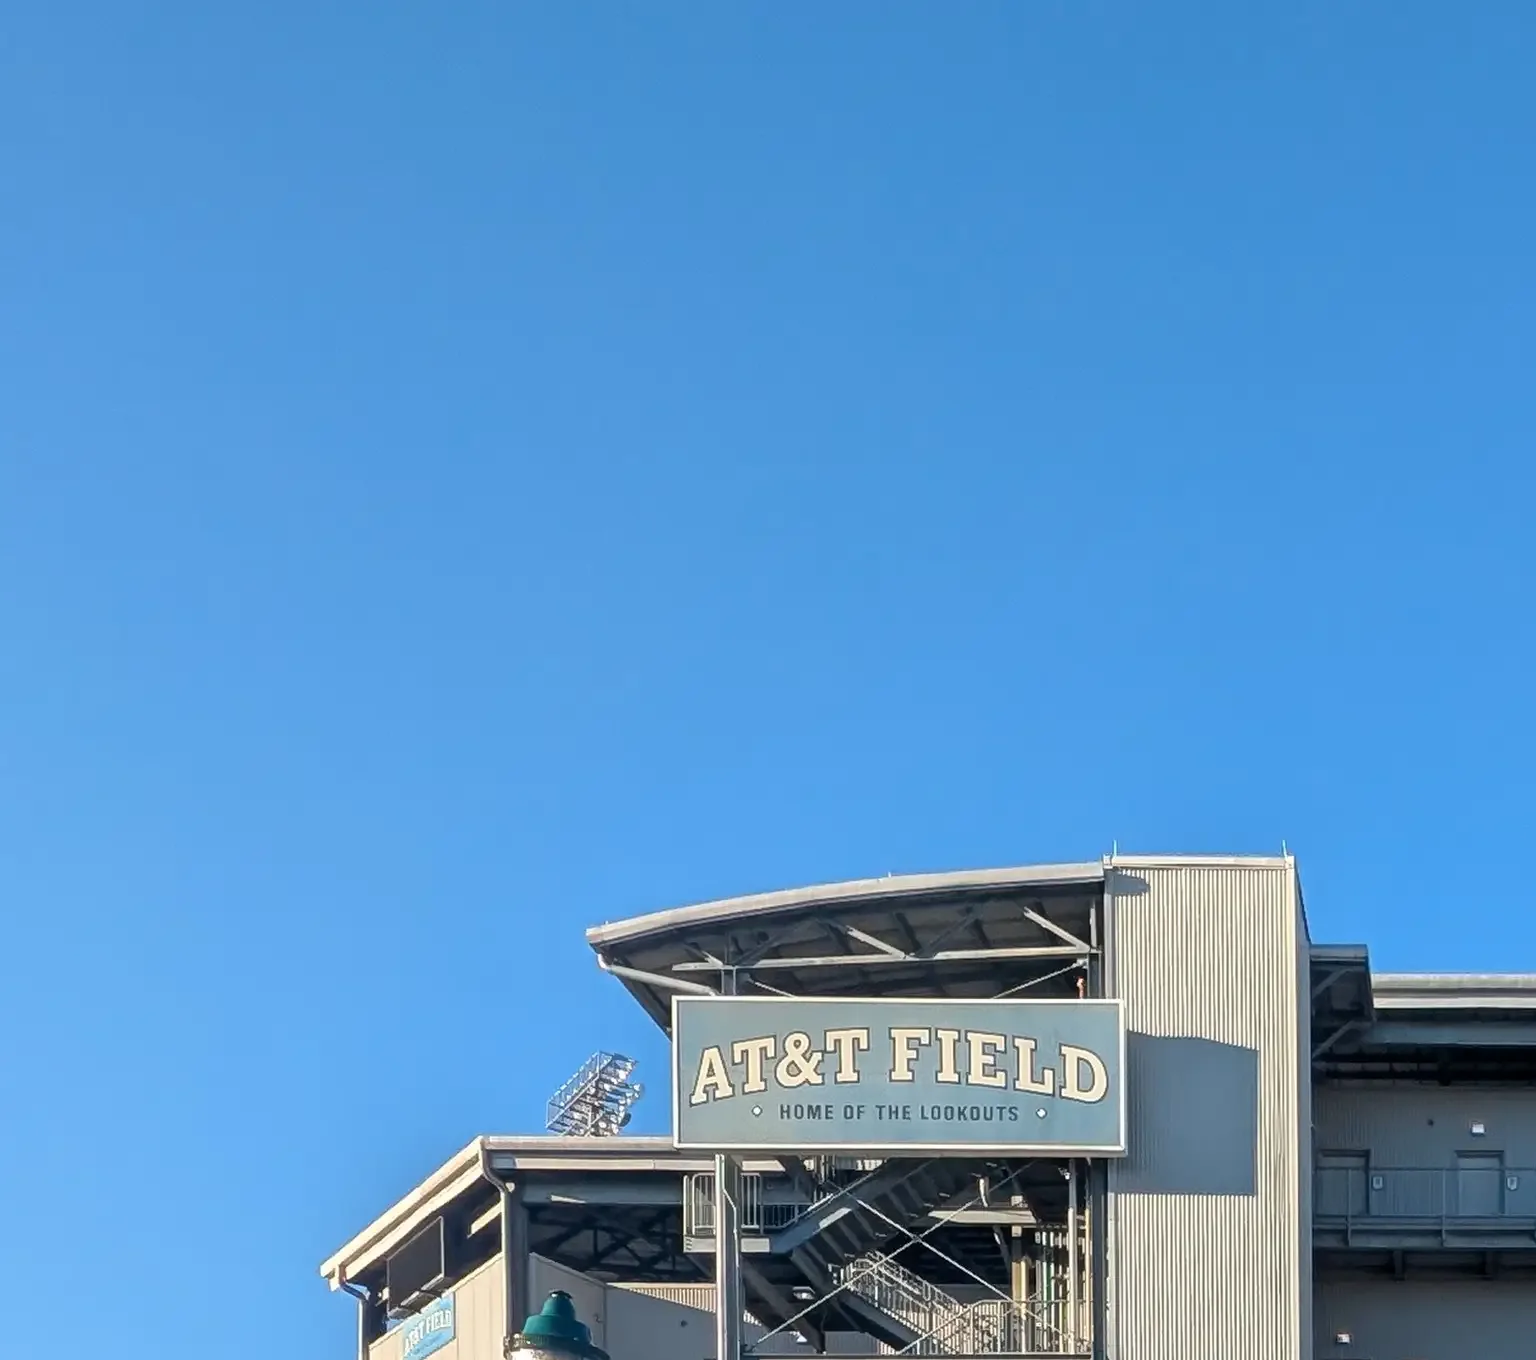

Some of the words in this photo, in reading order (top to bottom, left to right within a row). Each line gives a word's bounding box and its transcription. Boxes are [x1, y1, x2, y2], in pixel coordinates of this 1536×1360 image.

[689, 1027, 870, 1106] AT&T
[888, 1027, 1109, 1104] FIELD
[779, 1104, 834, 1121] HOME
[843, 1104, 867, 1121] OF
[877, 1104, 912, 1121] THE
[920, 1104, 1020, 1122] LOOKOUTS
